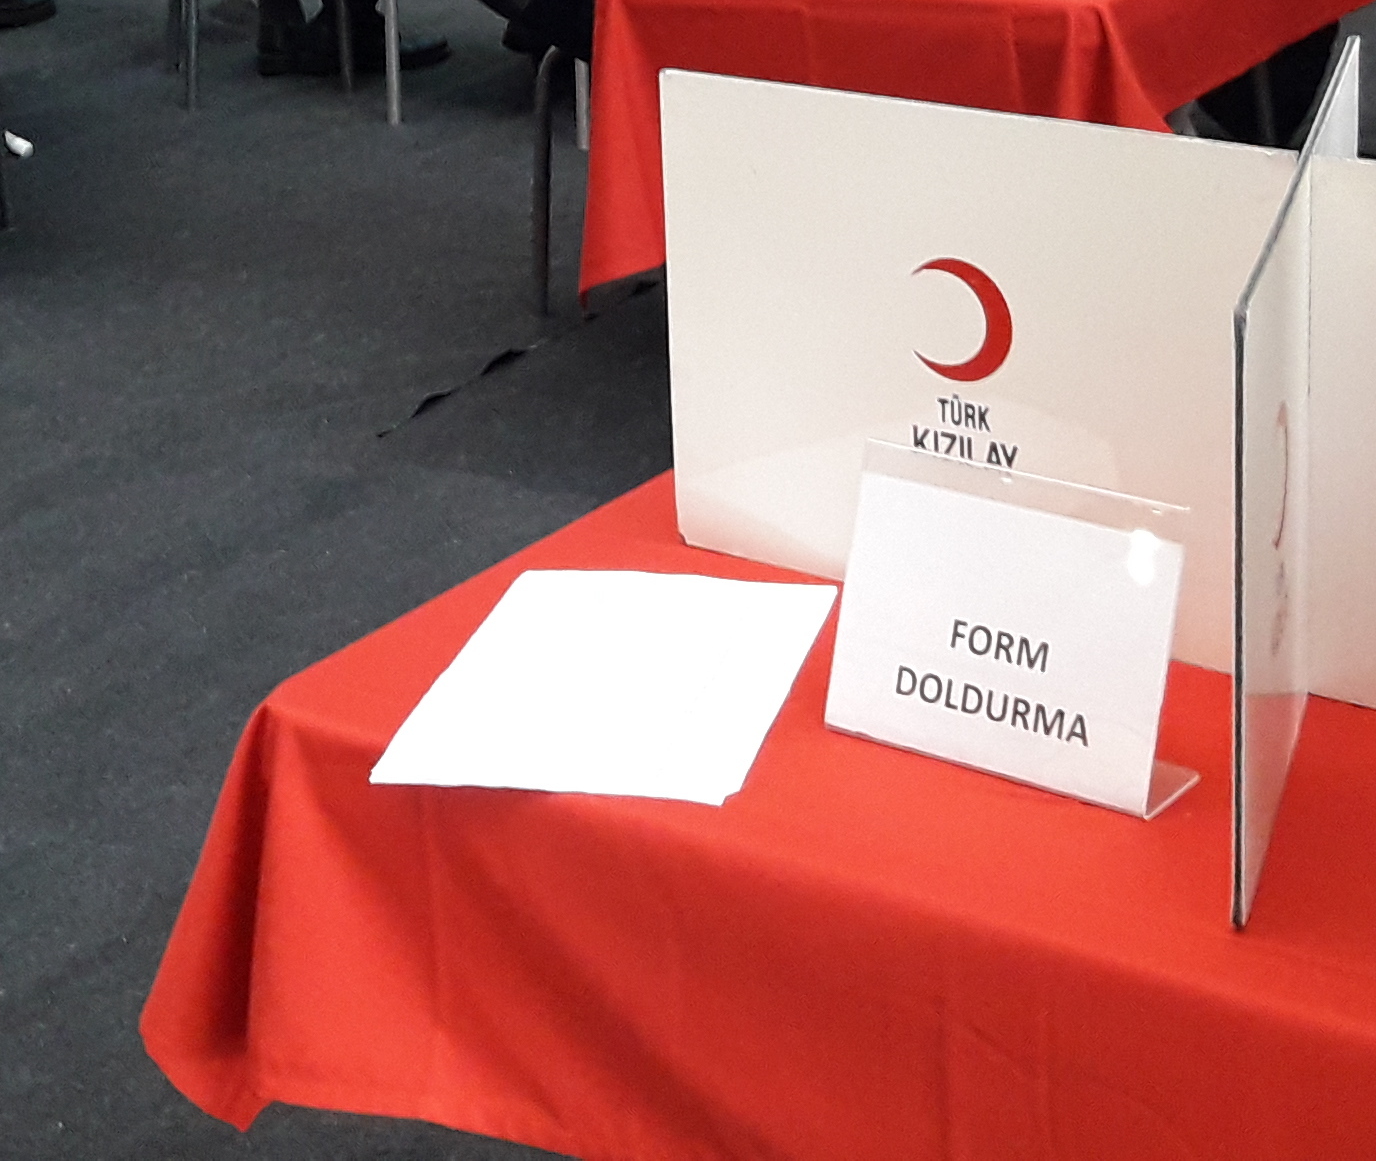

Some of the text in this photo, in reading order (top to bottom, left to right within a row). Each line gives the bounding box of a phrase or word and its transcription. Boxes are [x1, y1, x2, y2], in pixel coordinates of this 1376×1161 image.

[937, 393, 991, 432] TÜRK
[950, 619, 1049, 673] FORM
[895, 665, 1089, 747] DOLDURMA
